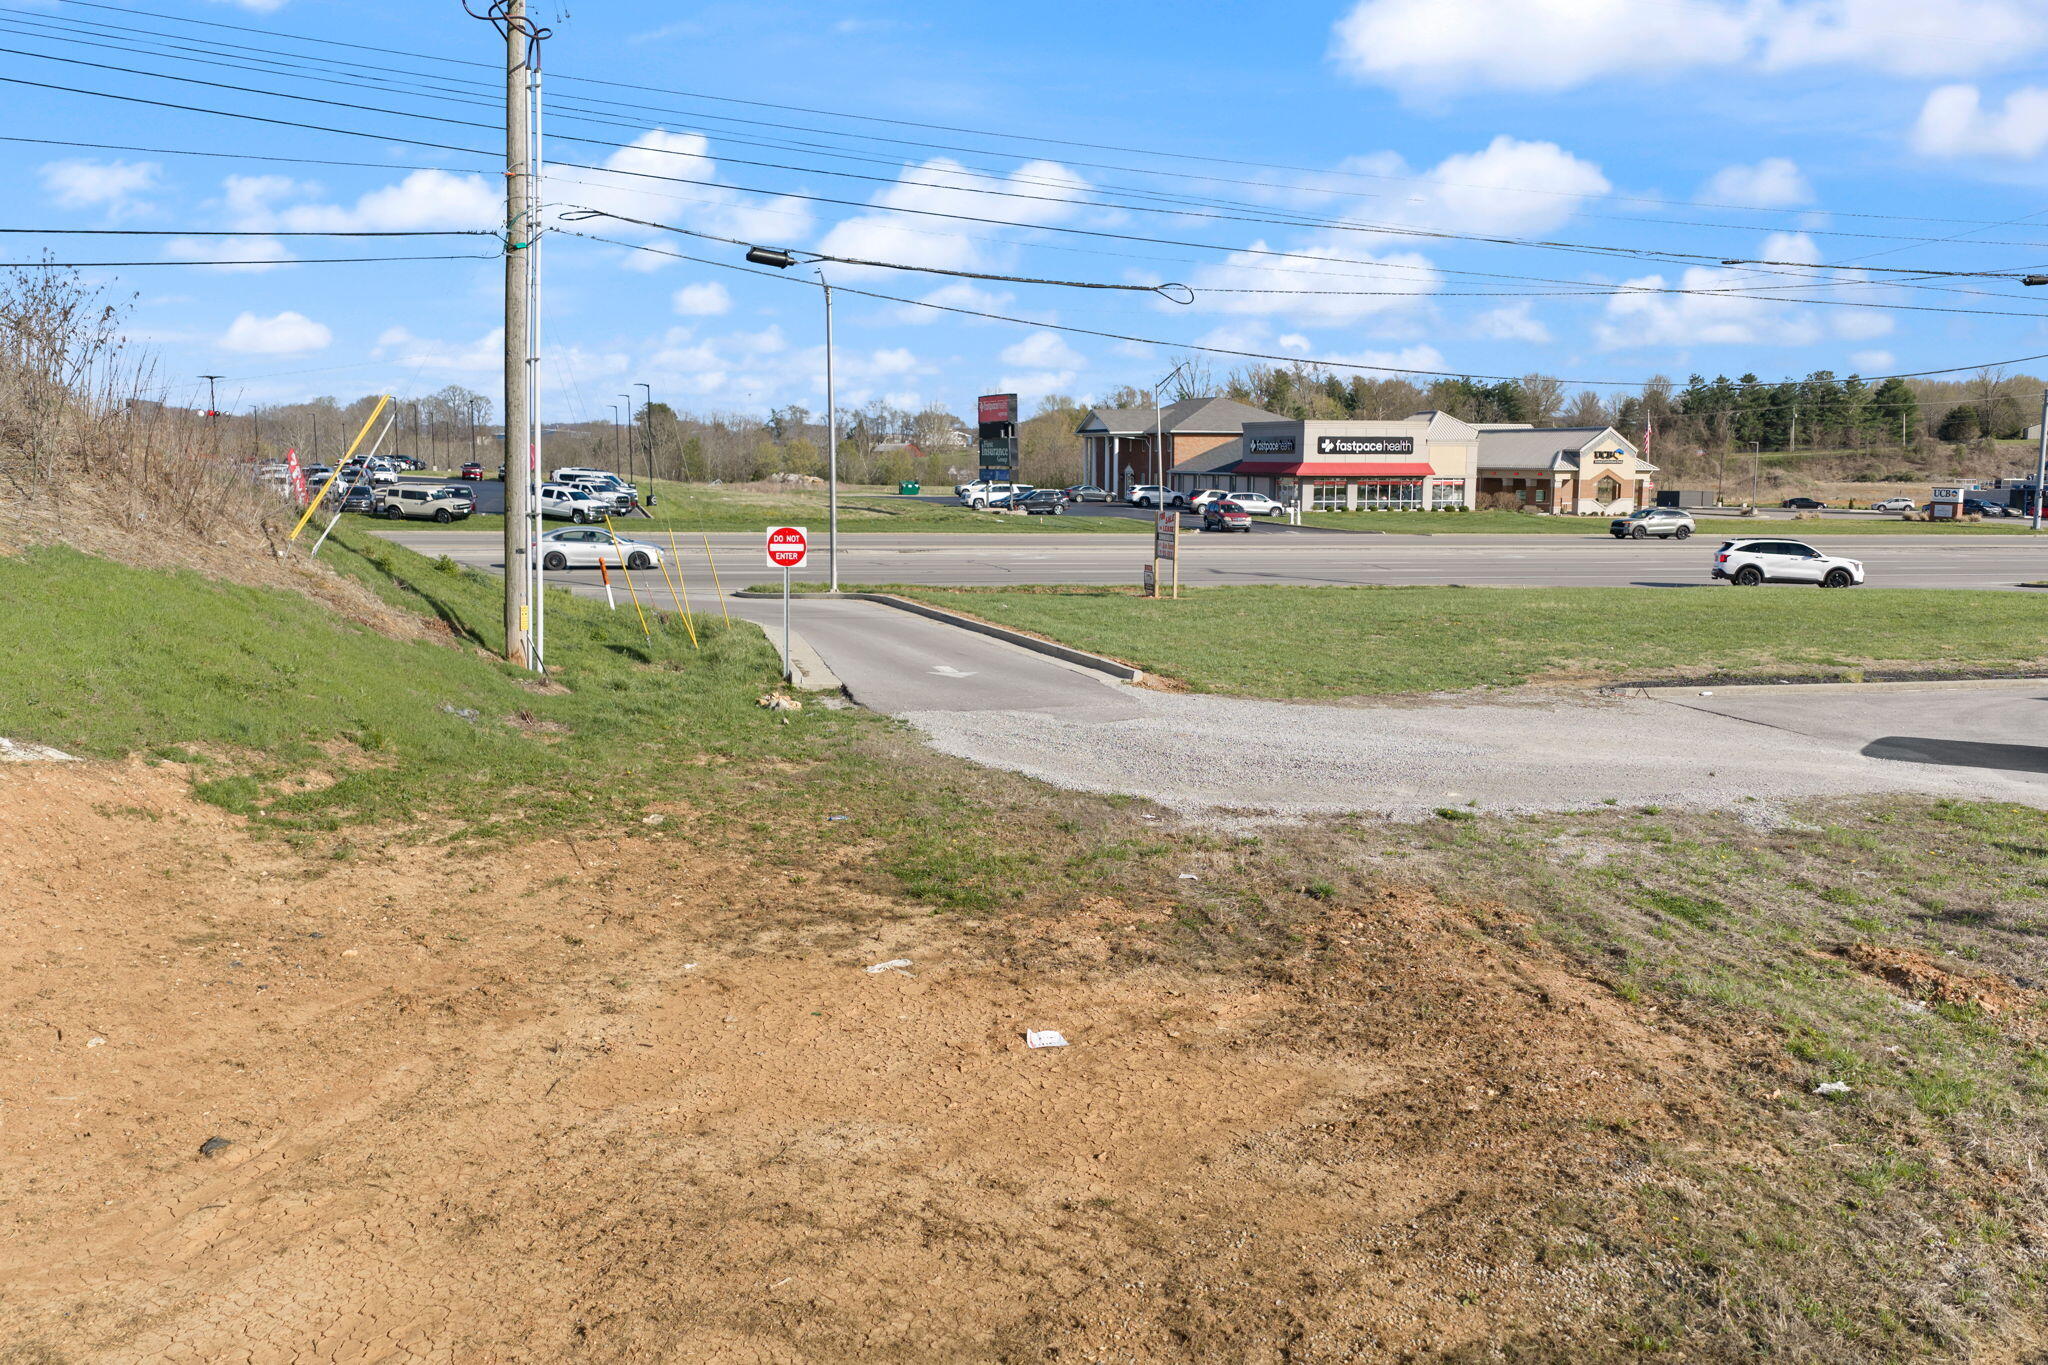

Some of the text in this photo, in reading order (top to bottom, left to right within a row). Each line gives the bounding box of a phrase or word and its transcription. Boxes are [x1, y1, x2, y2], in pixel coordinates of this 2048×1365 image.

[981, 444, 1008, 456] Insurance
[1336, 440, 1412, 453] fastpace health
[1934, 489, 1951, 497] UCB
[775, 552, 798, 560] ENTER
